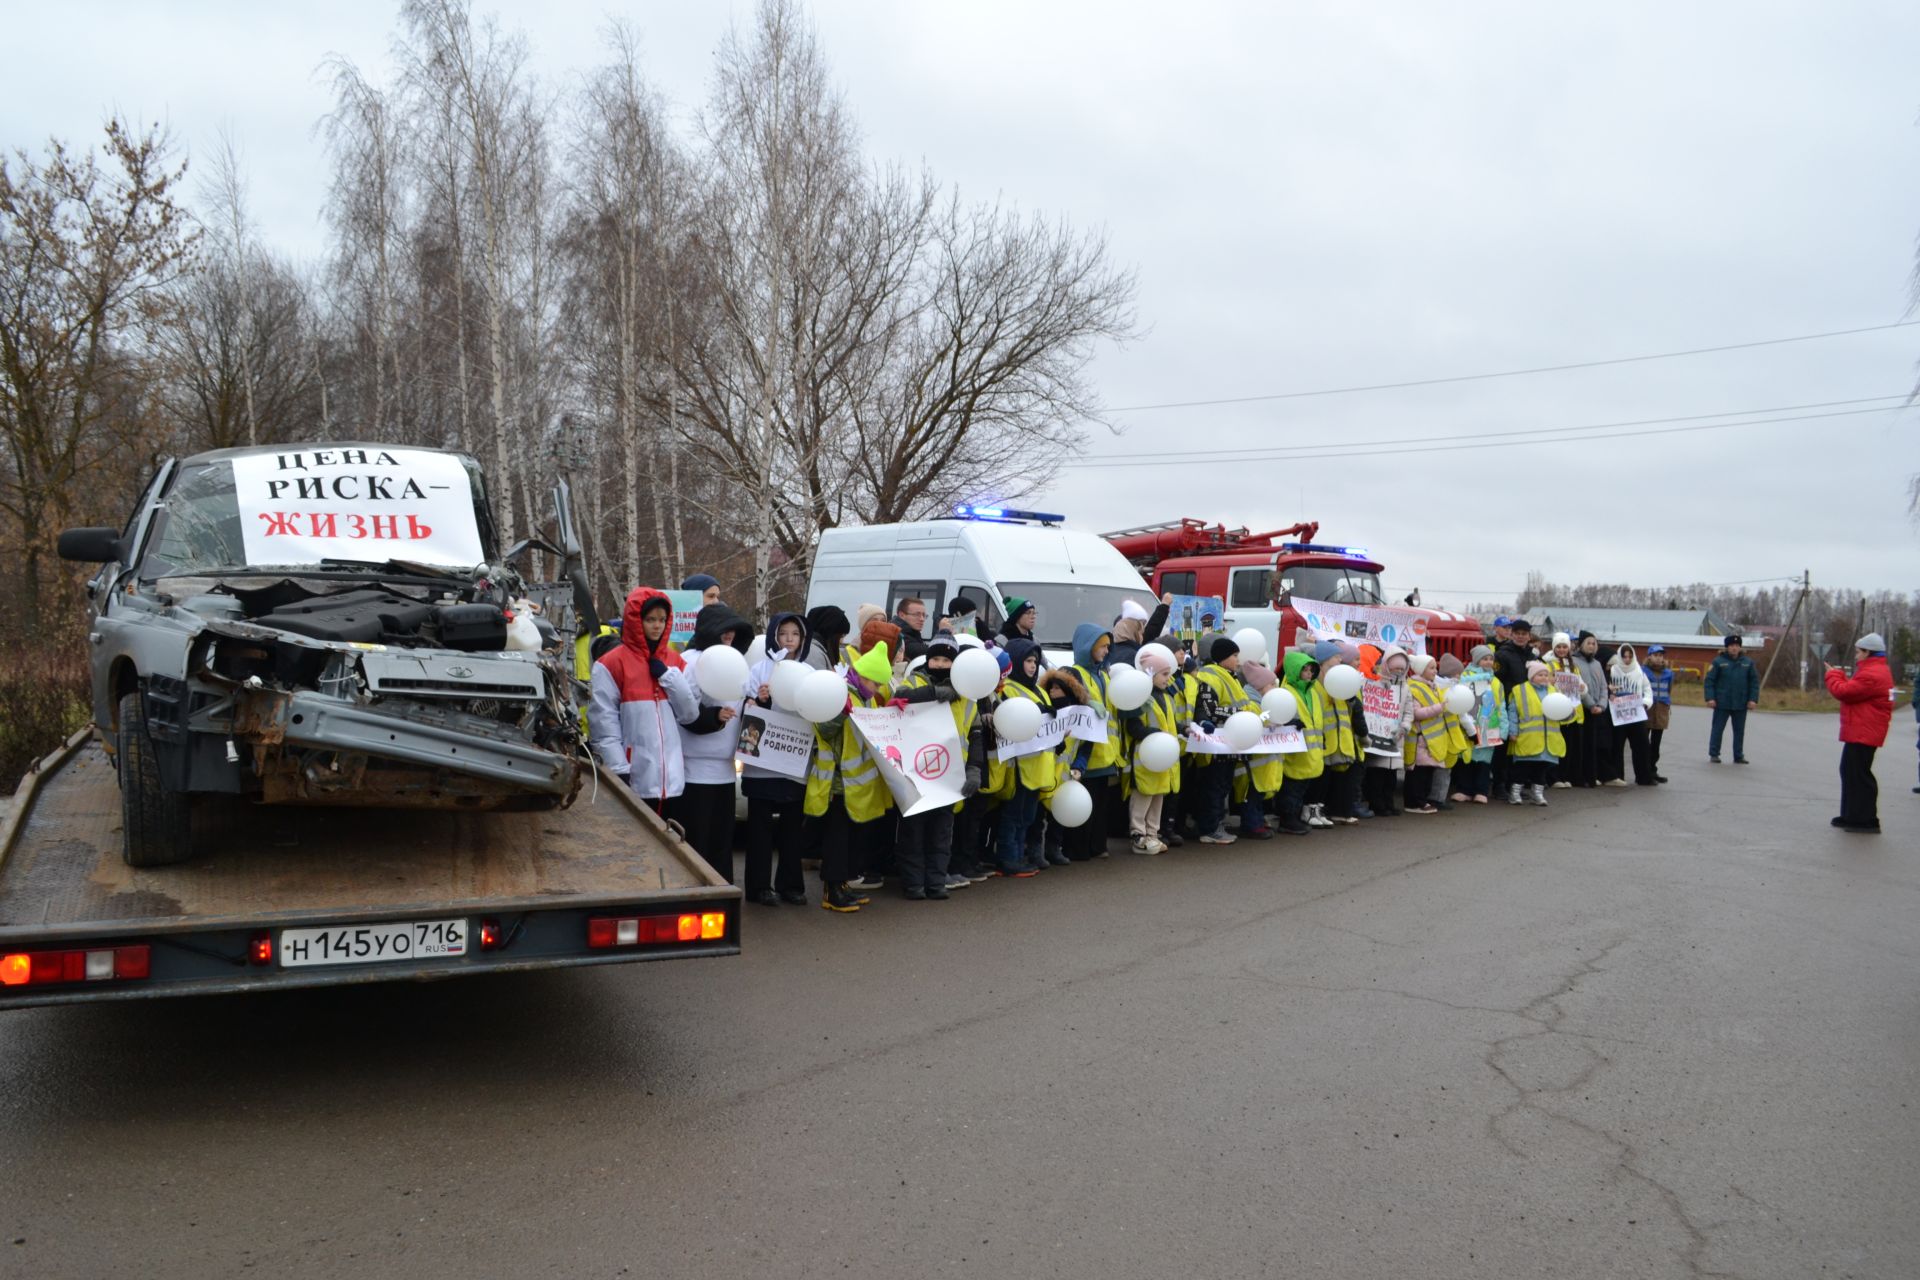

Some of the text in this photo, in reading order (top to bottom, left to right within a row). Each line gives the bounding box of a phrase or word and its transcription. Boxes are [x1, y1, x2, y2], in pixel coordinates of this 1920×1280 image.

[277, 450, 401, 471] ЦЕНА
[258, 511, 433, 540] ЖИЗНЬ
[765, 729, 809, 746] пристегни
[763, 738, 808, 756] РОДНОГО!
[425, 943, 447, 954] RUS
